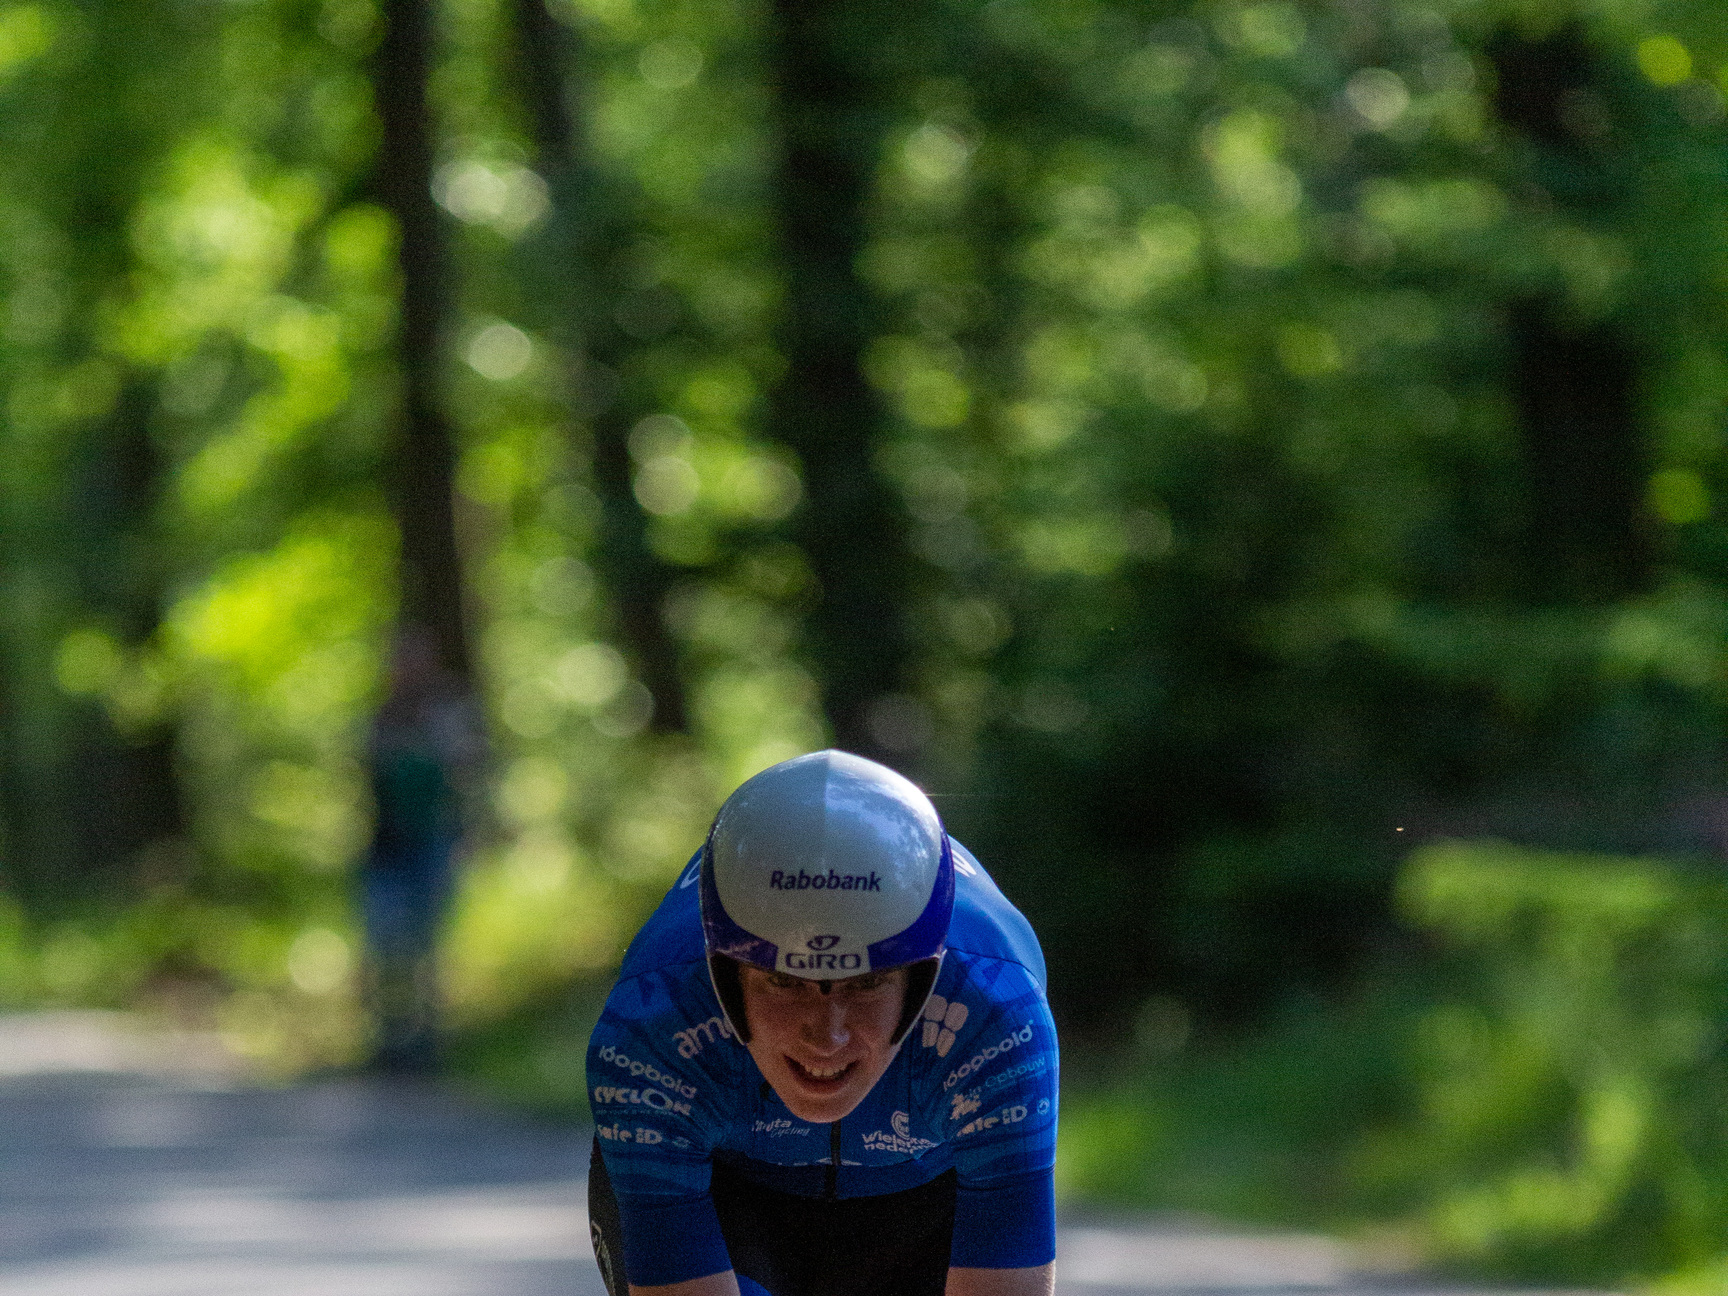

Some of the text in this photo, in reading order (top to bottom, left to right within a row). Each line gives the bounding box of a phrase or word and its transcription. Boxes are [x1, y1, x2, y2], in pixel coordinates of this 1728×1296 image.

[770, 869, 881, 891] Rabobank
[785, 953, 861, 969] GIRO
[673, 1017, 736, 1058] am
